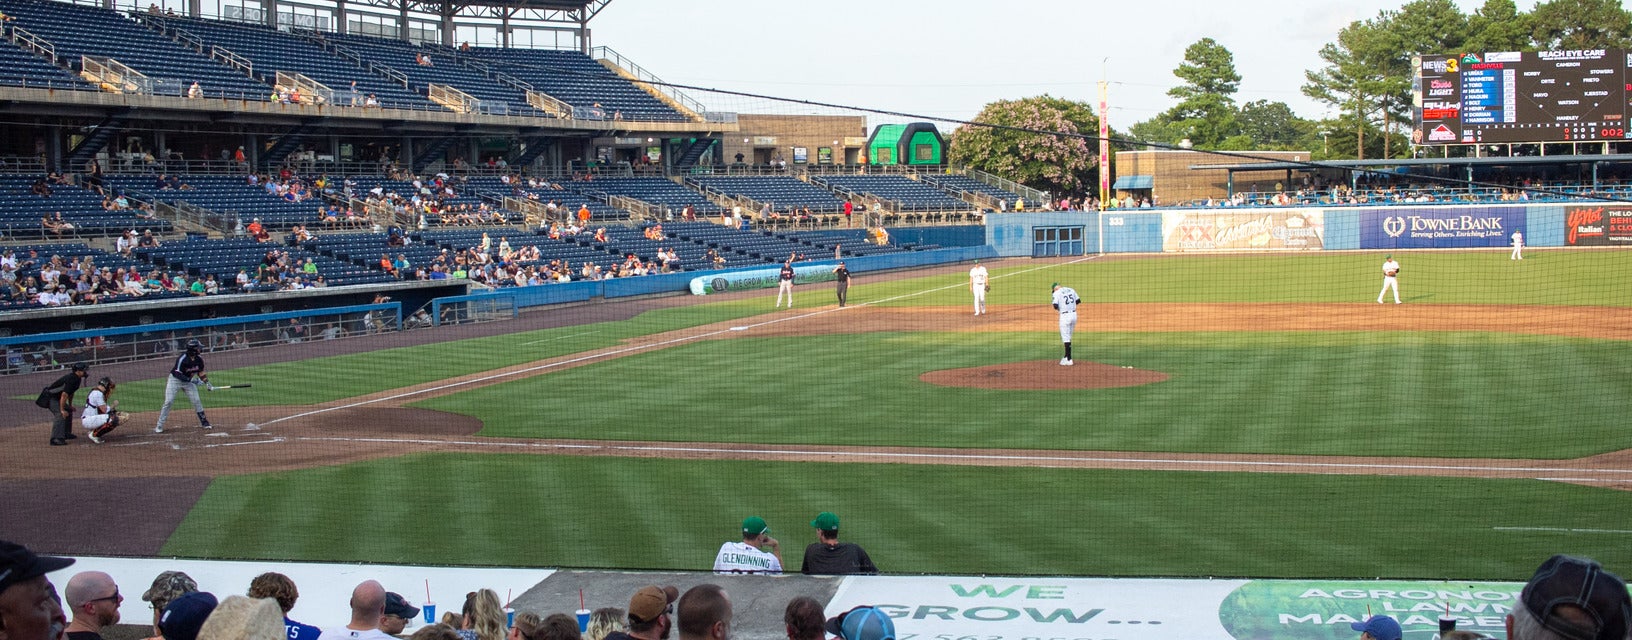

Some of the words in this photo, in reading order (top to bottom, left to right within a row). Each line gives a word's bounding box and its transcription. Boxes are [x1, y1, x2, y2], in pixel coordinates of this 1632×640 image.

[1423, 61, 1447, 70] NEWS
[1446, 58, 1458, 72] 3
[1423, 109, 1458, 118] ESPN
[1578, 225, 1603, 233] Italian
[1411, 231, 1434, 239] Serving
[1456, 230, 1485, 239] Enriching
[733, 279, 743, 289] WE
[1063, 294, 1075, 305] 25
[722, 553, 771, 569] GLENDINNING
[949, 584, 1068, 599] WE
